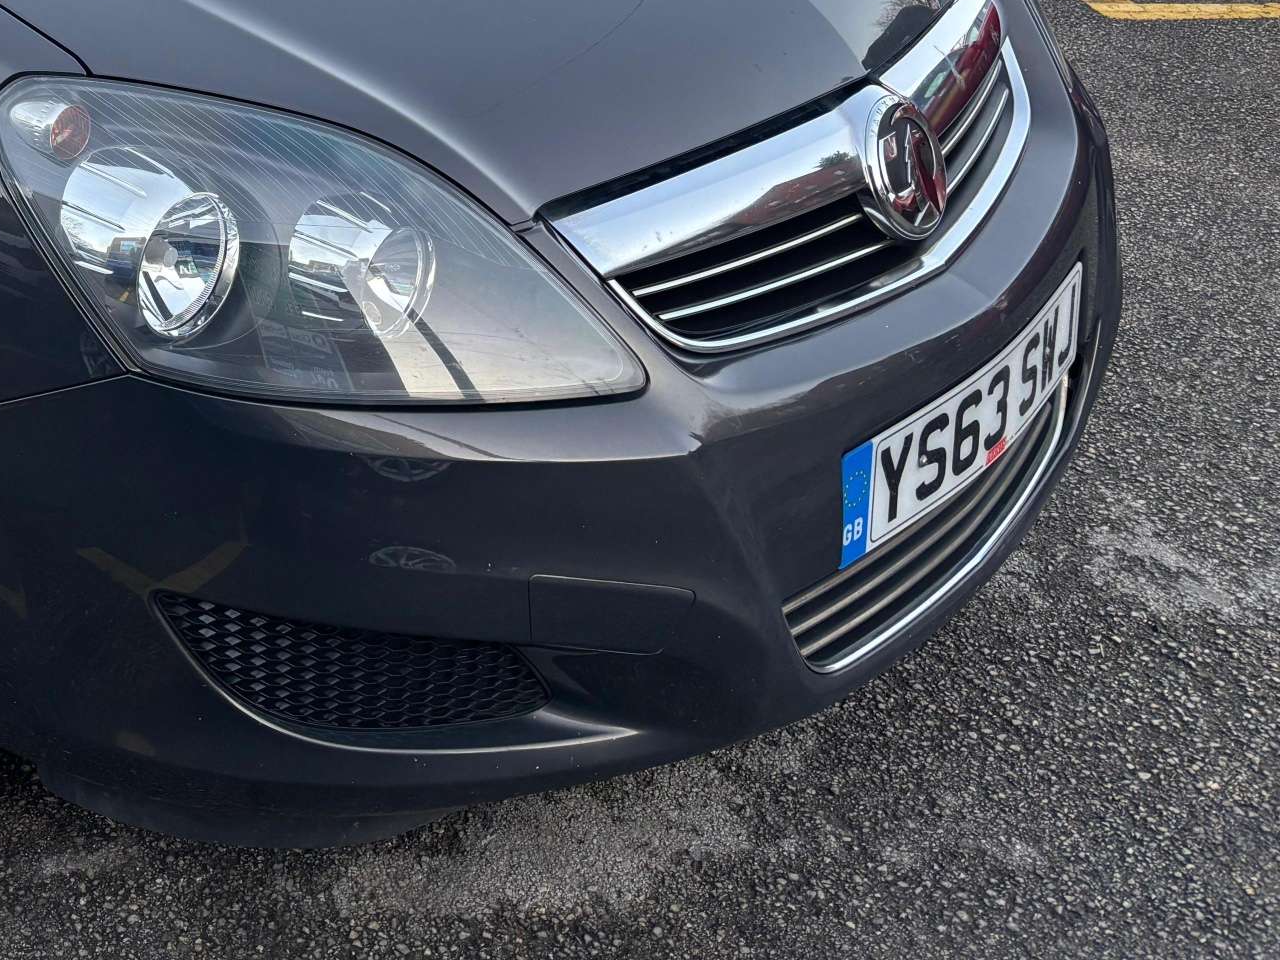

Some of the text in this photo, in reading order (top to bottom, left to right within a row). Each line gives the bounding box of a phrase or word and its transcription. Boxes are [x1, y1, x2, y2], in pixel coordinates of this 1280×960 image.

[880, 281, 1078, 523] YS63 SWJ
[843, 517, 863, 546] GB
